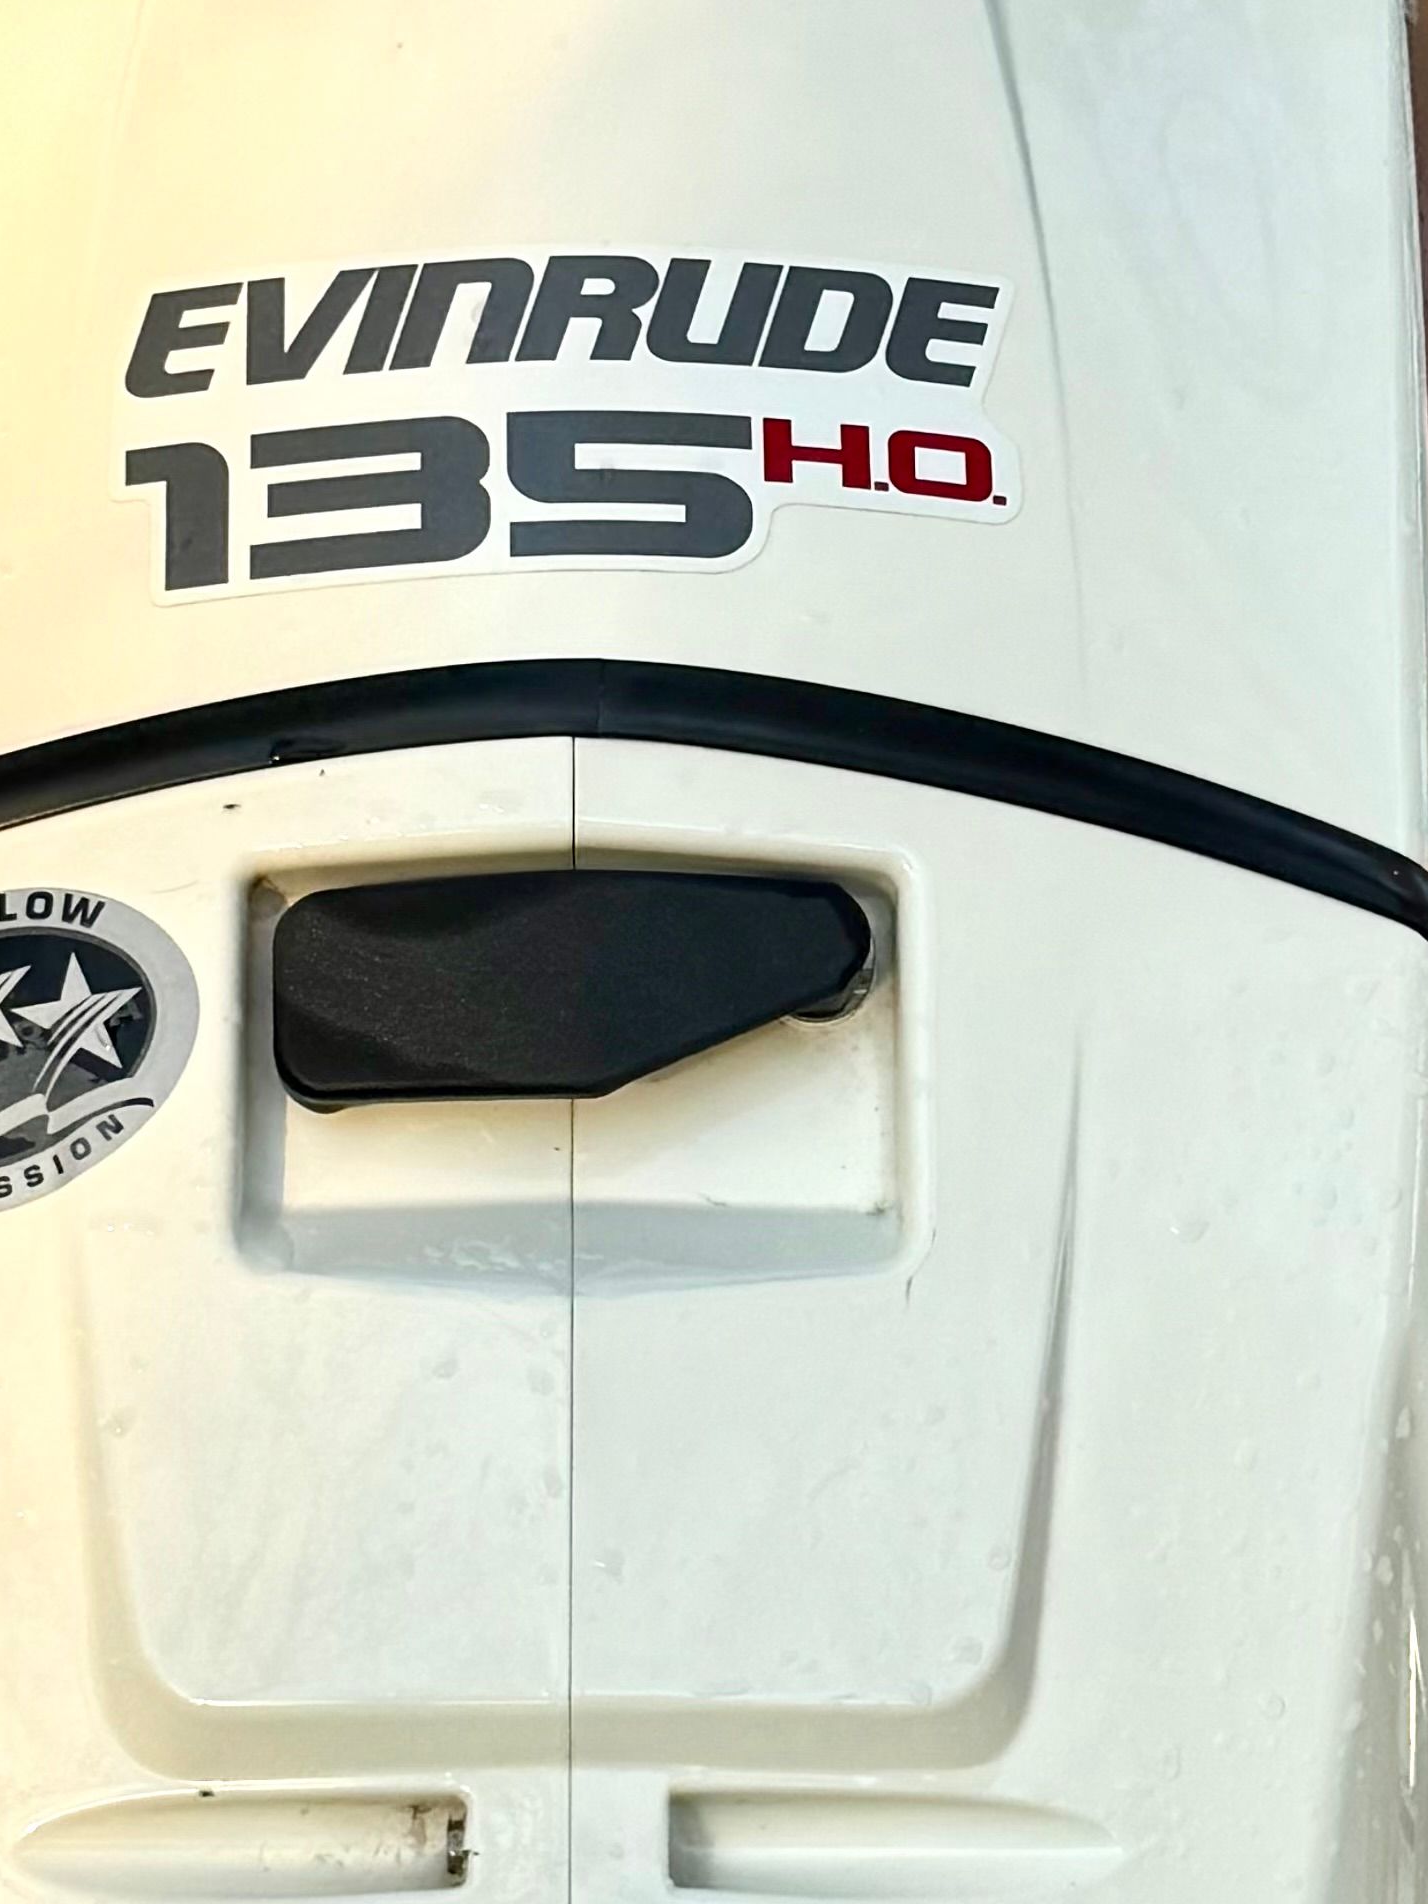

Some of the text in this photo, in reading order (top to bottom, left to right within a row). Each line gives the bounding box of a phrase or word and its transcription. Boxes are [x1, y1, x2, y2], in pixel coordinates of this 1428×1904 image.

[125, 255, 1000, 399] EVINRUDE
[125, 410, 1007, 590] 135 H.O.
